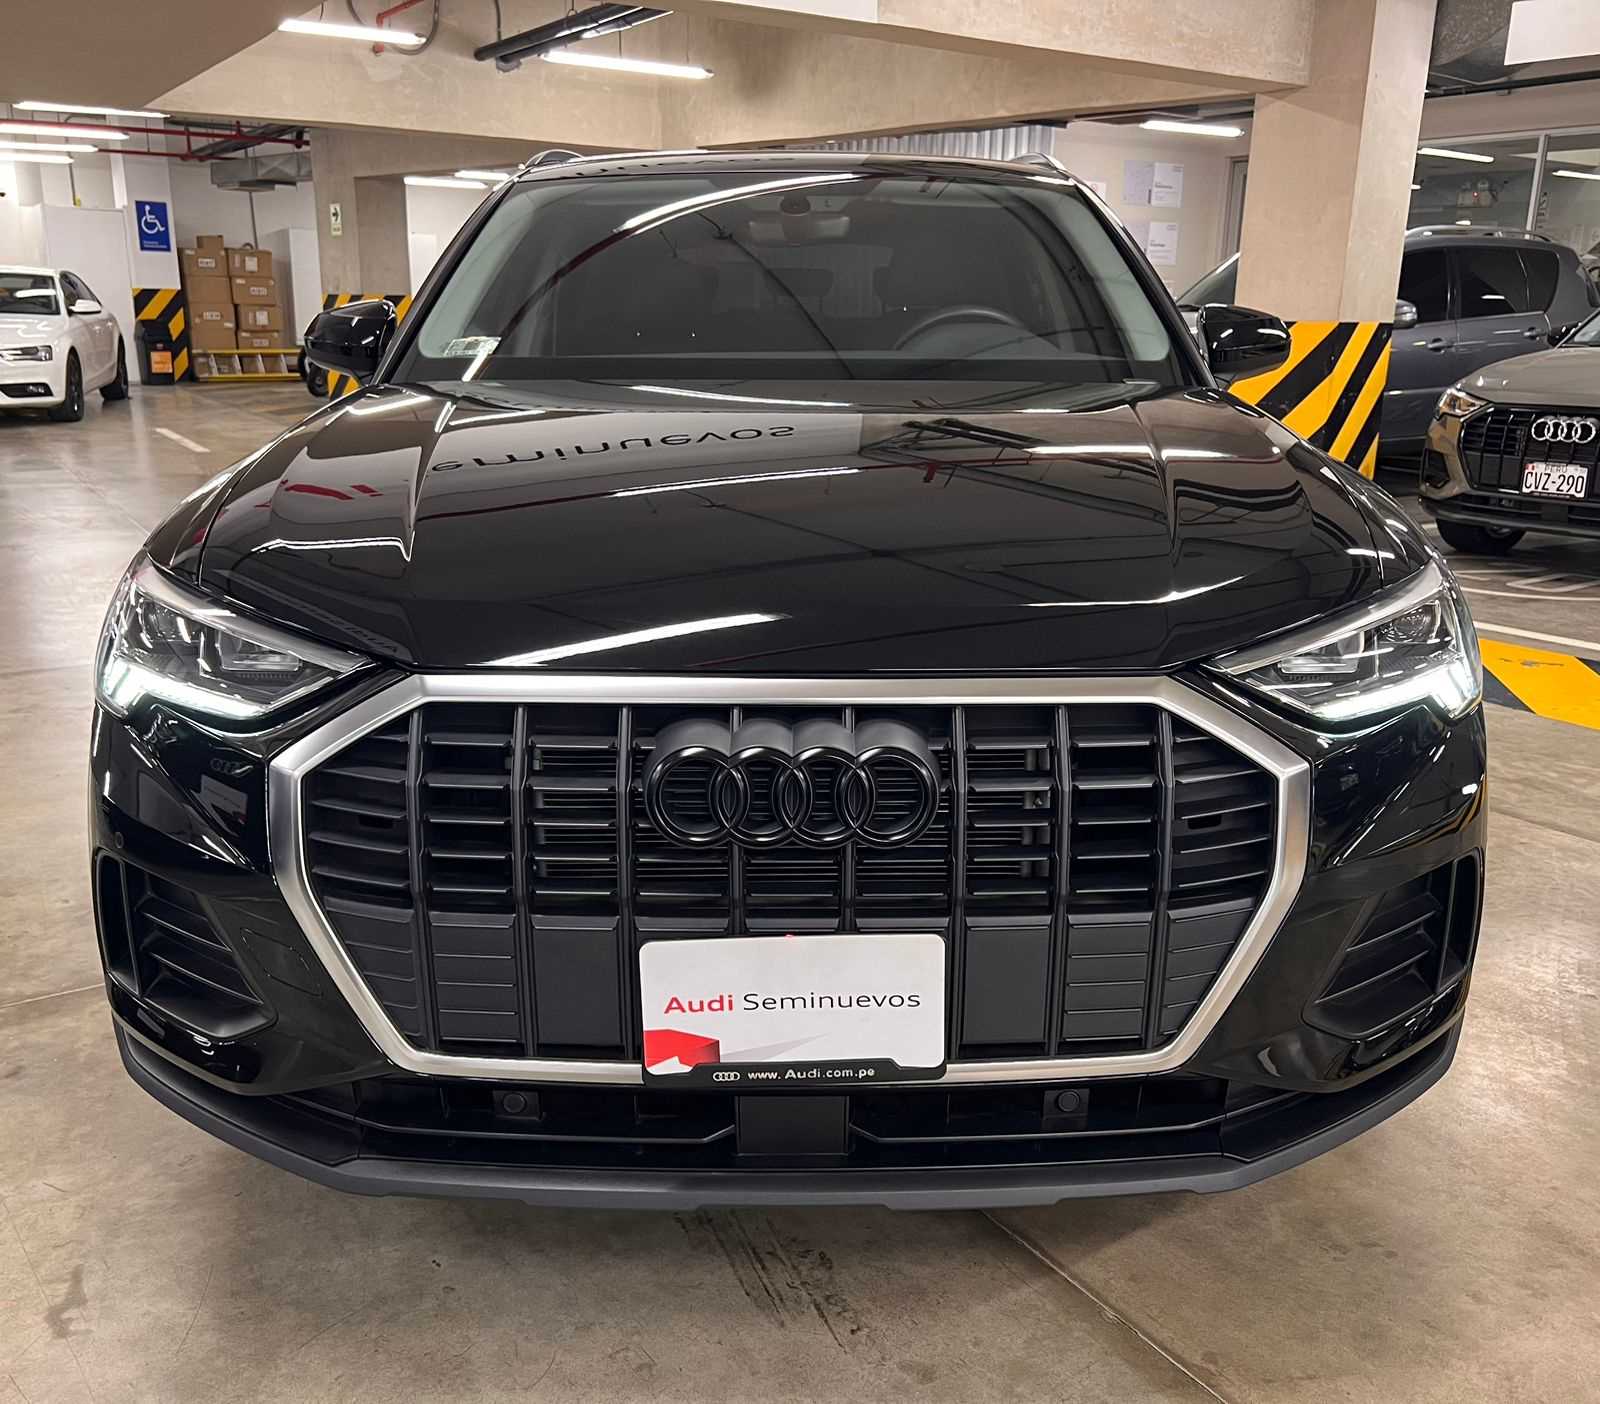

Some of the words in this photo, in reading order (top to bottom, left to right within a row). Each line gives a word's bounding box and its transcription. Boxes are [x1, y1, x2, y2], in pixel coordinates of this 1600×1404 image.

[1524, 472, 1585, 494] CVZ-290
[663, 994, 734, 1014] Audi
[743, 992, 921, 1011] Seminuevos
